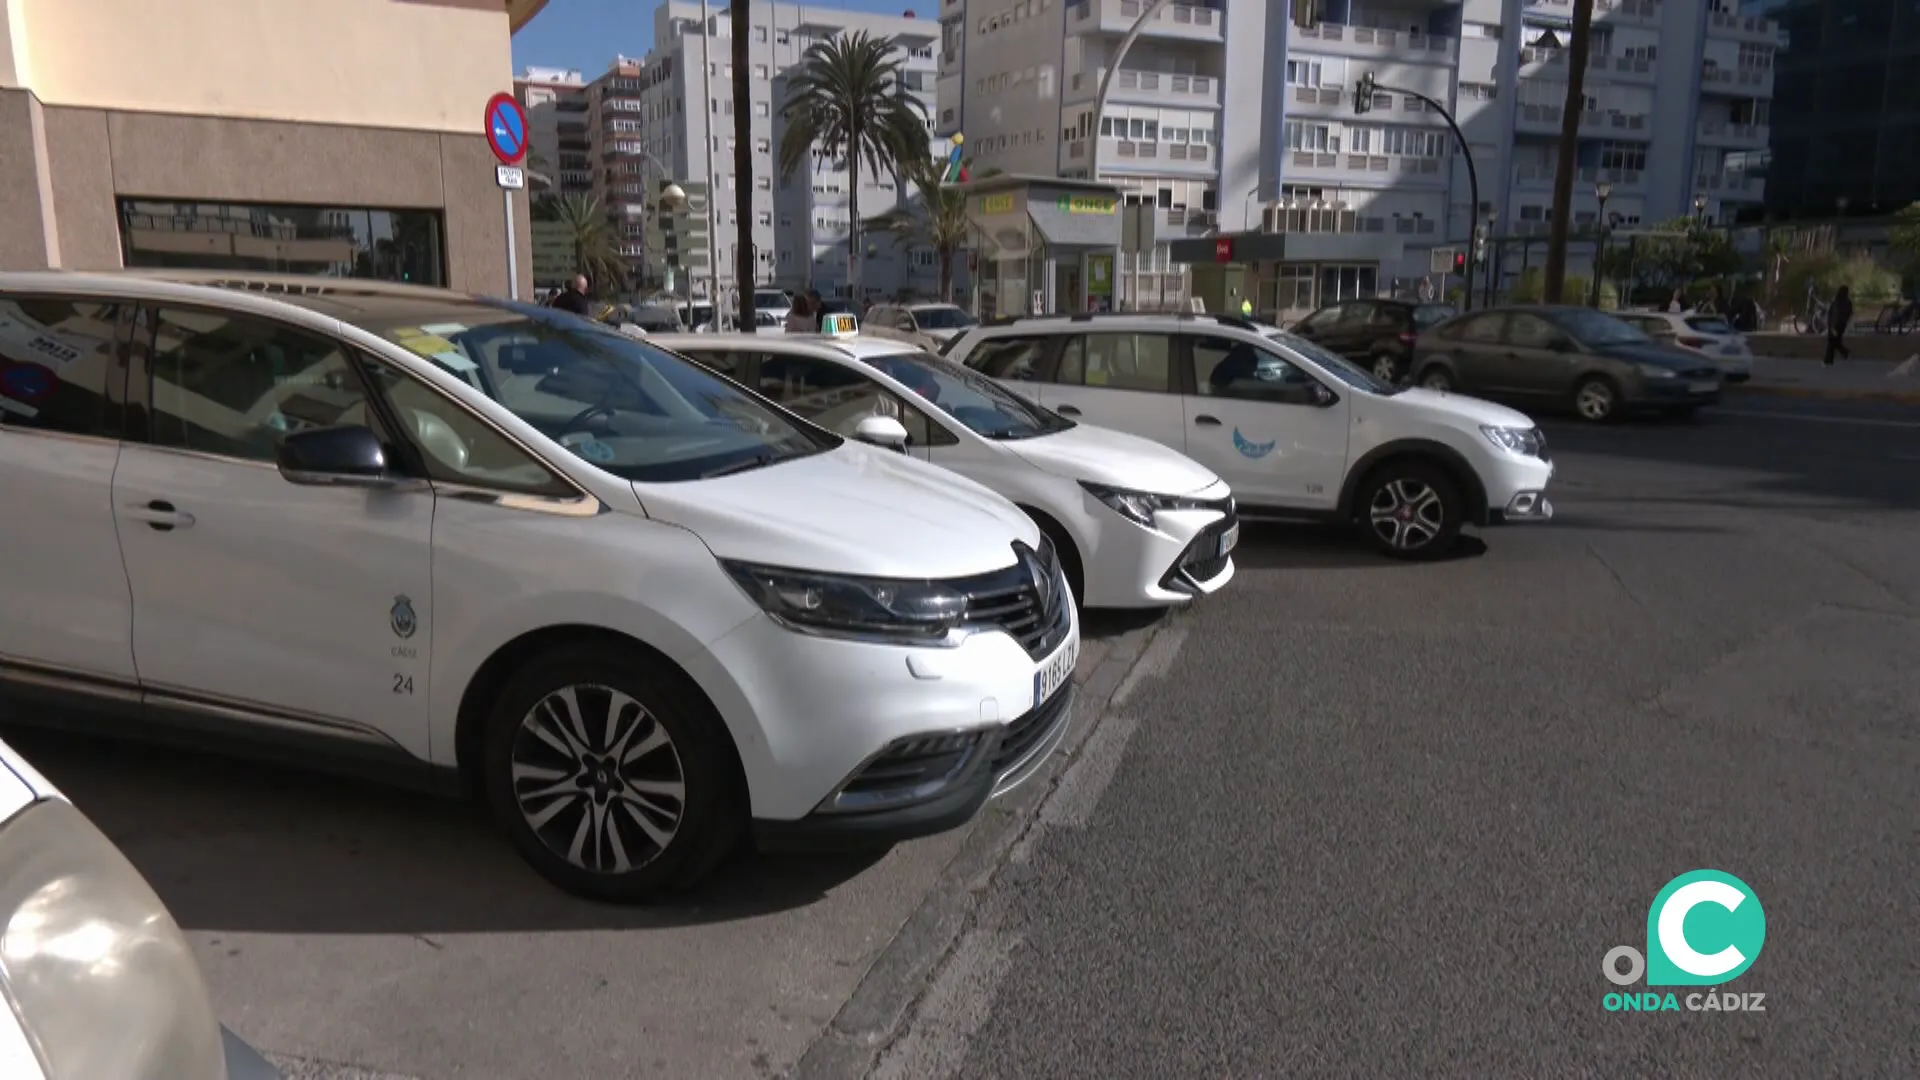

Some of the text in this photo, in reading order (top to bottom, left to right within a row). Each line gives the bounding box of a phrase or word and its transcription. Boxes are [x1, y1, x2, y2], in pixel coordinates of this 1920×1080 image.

[1074, 199, 1112, 211] ONCE
[838, 317, 852, 331] TAXI
[393, 672, 413, 695] 24
